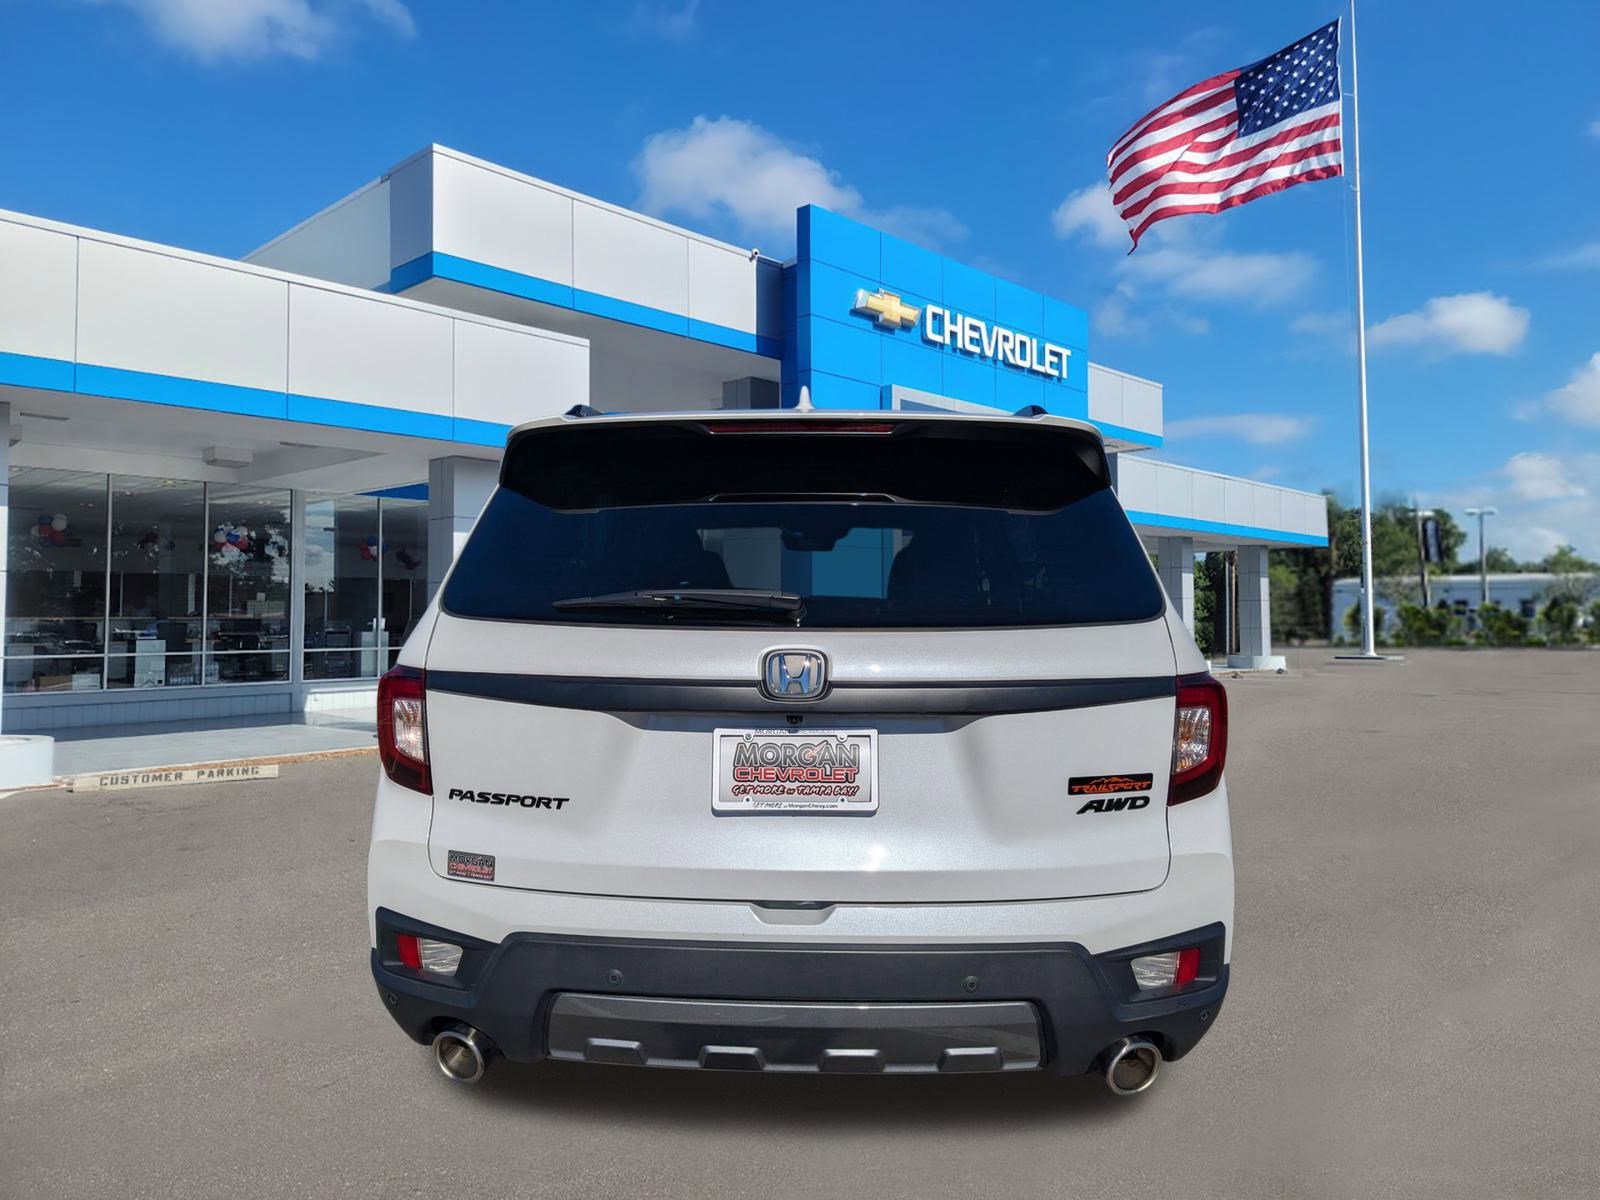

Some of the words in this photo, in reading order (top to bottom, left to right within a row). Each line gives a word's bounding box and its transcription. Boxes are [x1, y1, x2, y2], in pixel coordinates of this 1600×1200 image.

[925, 304, 1072, 379] CHEVROLET
[733, 740, 860, 768] MORGAN
[99, 771, 184, 787] CUSTOMER
[197, 766, 260, 780] PARKING
[733, 766, 859, 783] CHEVROLET
[448, 788, 570, 810] PASSPORT
[732, 784, 754, 796] GET
[753, 785, 786, 796] MORE
[796, 785, 832, 796] TAMPA
[833, 785, 860, 797] BAY!
[1076, 796, 1151, 815] AWD
